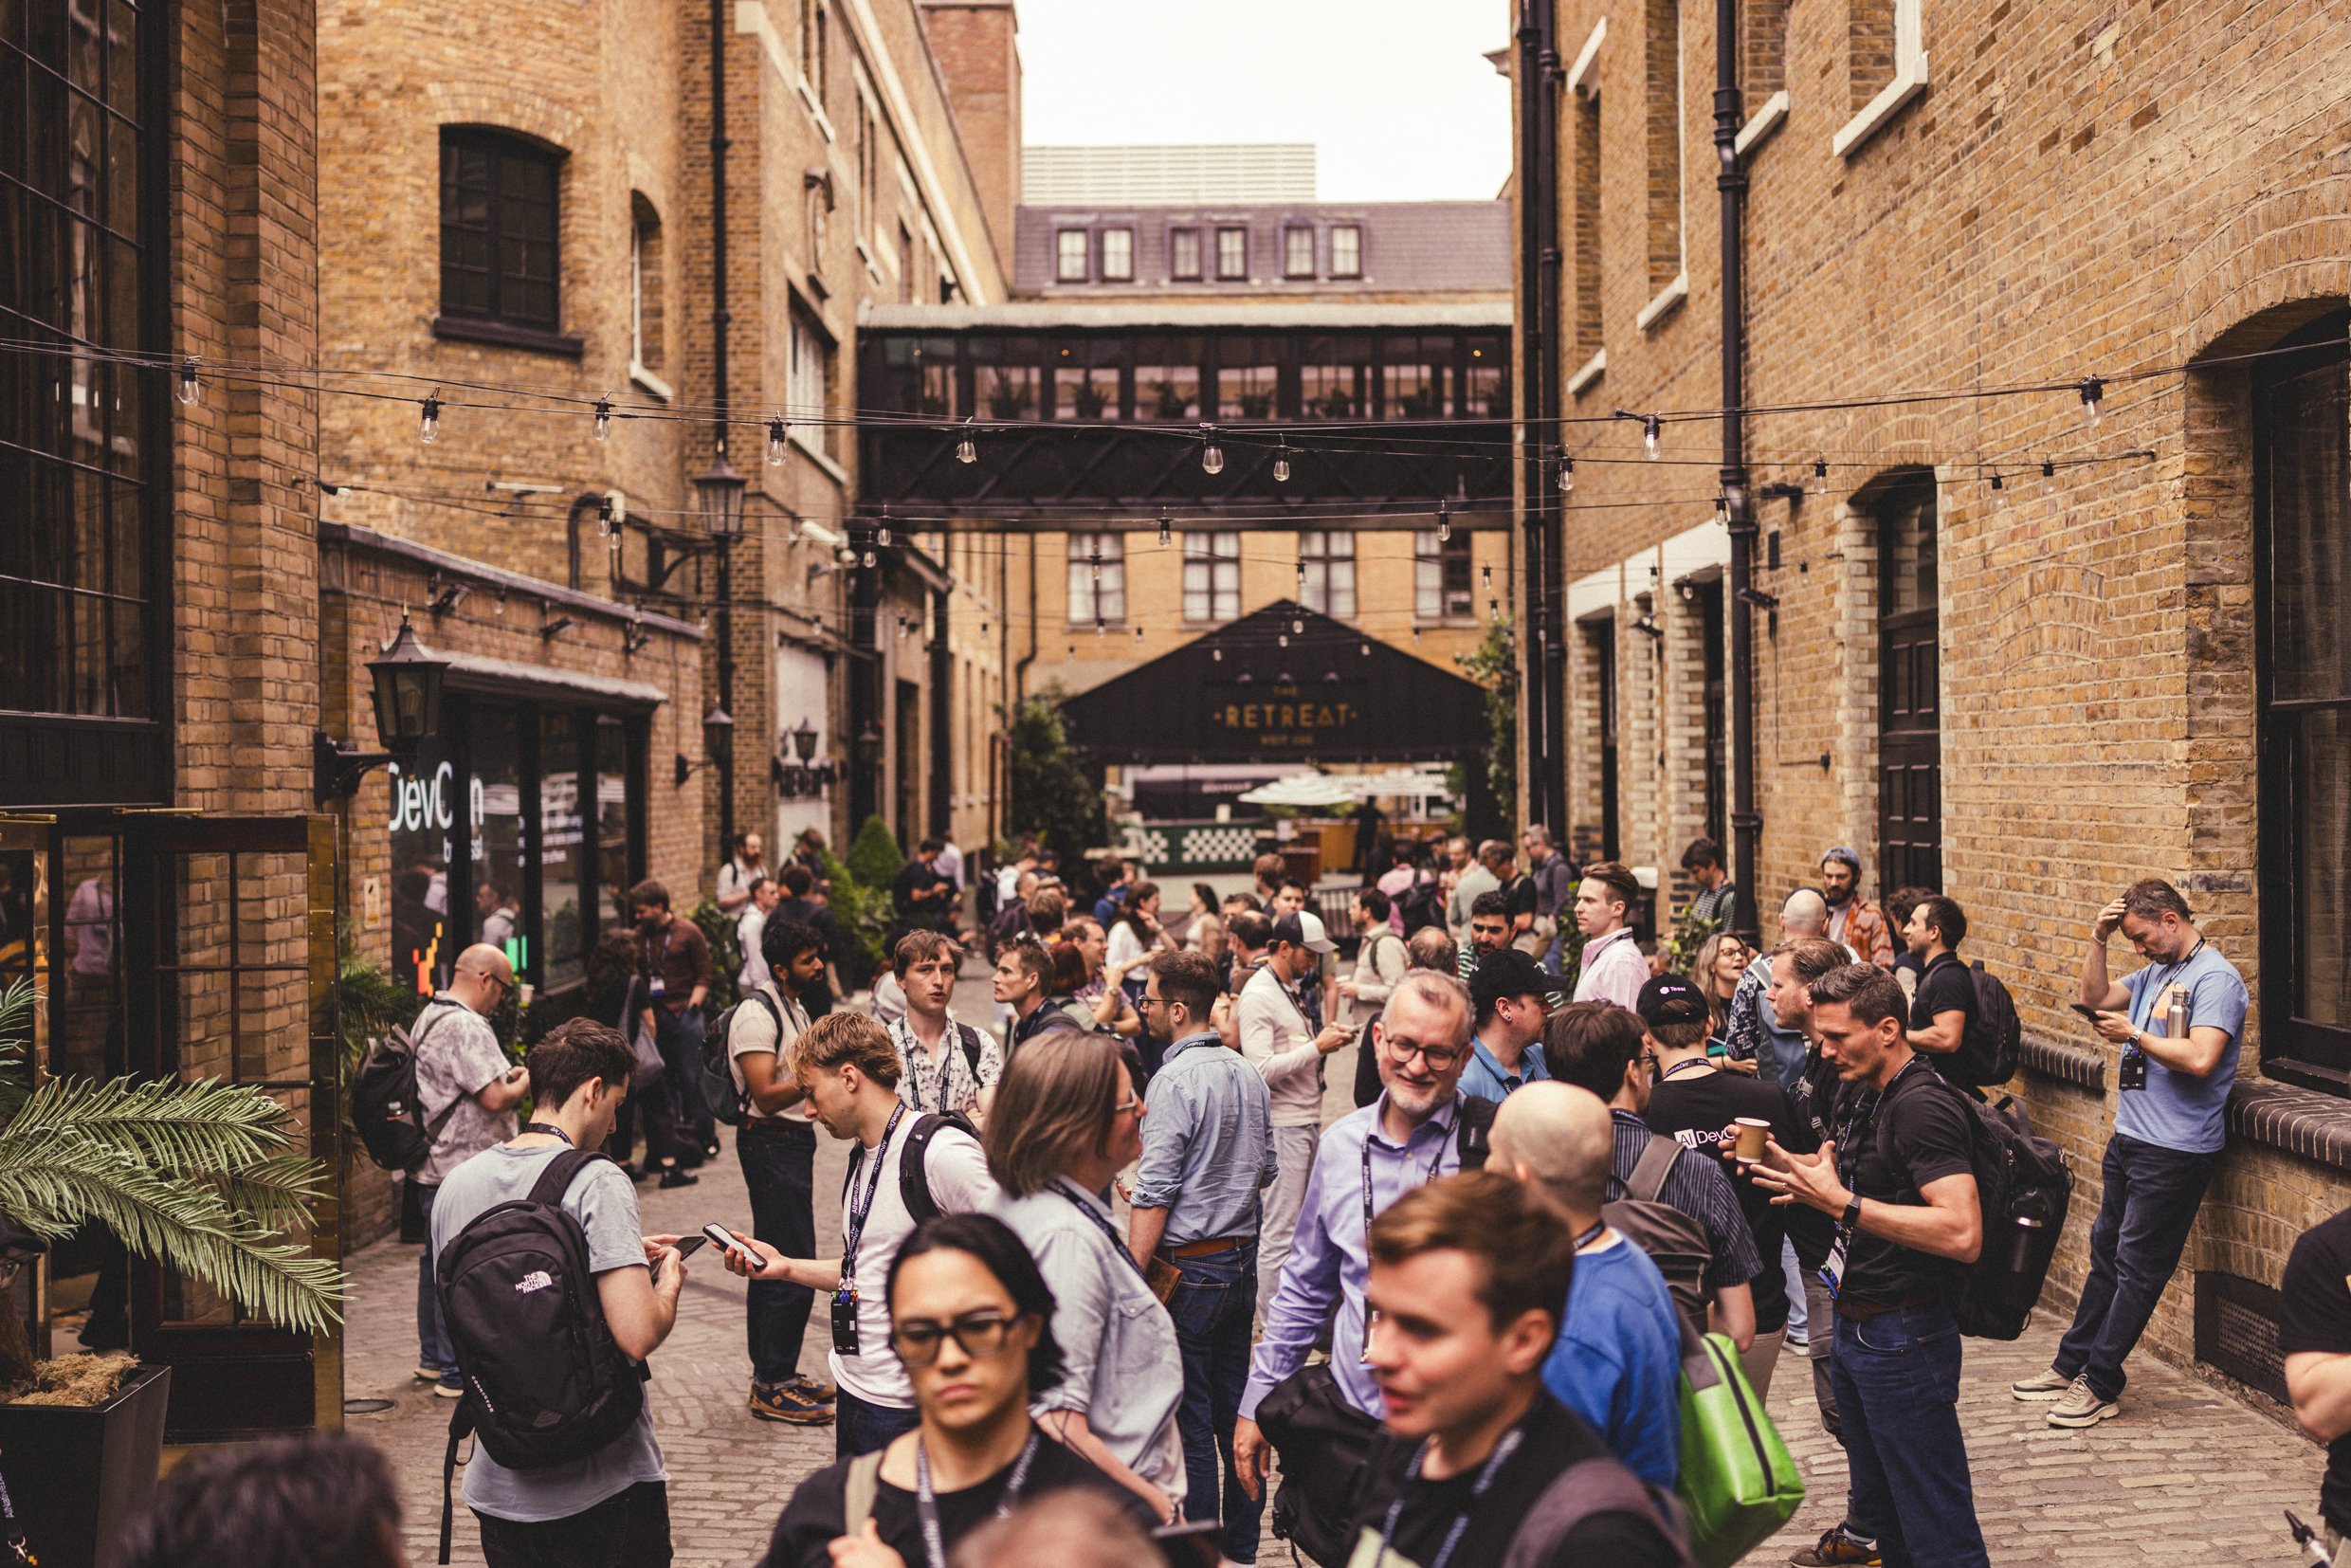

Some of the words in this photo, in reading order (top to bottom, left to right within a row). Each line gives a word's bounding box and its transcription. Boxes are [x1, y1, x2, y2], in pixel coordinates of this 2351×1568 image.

[1225, 703, 1350, 728] RETREAT
[388, 760, 484, 831] DevCn
[1696, 1126, 1736, 1144] DevC
[0, 1472, 15, 1519] AINative
